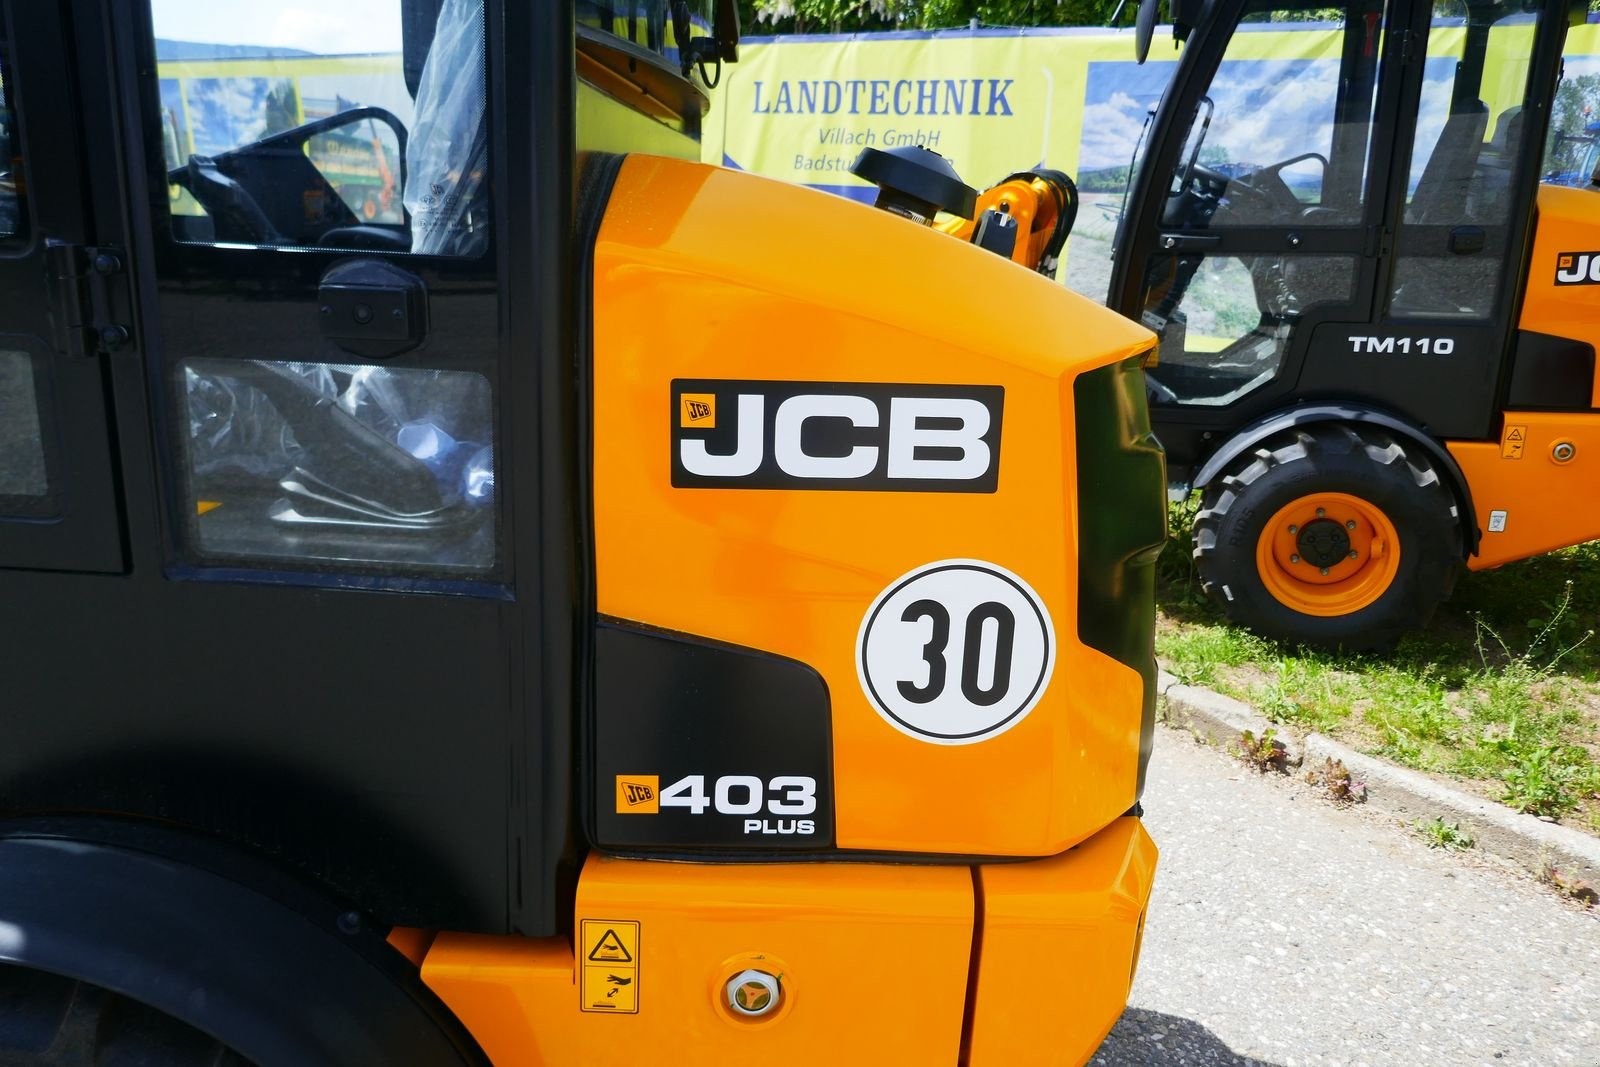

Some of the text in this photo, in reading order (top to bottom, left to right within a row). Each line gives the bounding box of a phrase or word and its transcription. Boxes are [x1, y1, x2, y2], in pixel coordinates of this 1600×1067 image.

[752, 79, 1014, 116] LANDTECHNIK
[818, 128, 941, 147] Villach GmbH
[1348, 336, 1454, 355] TM110
[689, 401, 711, 419] JCB
[680, 394, 991, 479] JCB
[896, 599, 1016, 706] 30
[626, 775, 817, 815] JCB 403
[744, 819, 815, 835] PLUS
